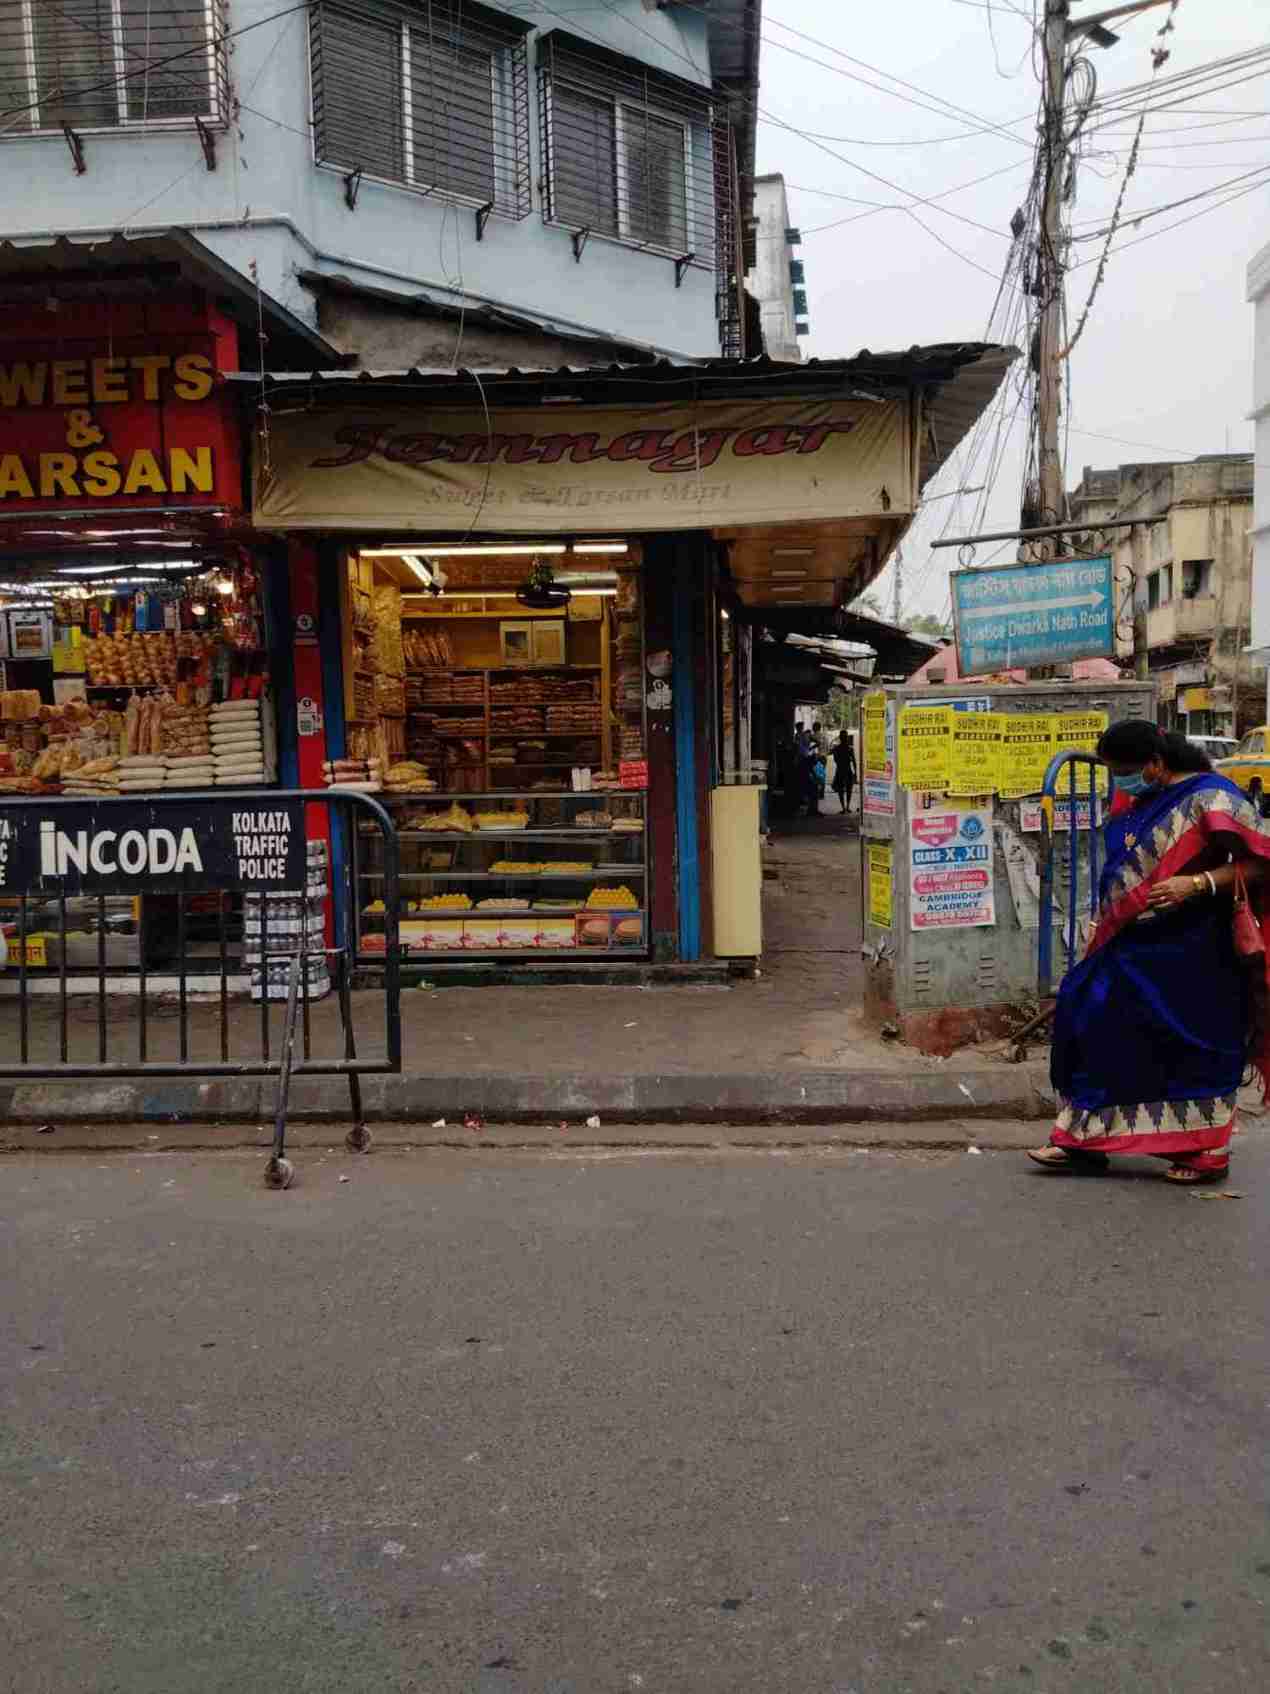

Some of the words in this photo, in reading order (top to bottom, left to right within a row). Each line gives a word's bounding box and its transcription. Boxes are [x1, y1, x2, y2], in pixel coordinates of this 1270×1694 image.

[64, 409, 104, 448] &
[309, 420, 853, 472] Jamnagar
[1080, 608, 1108, 625] Road
[232, 811, 291, 834] KOLKATA
[234, 835, 289, 857] TRAFFIC
[239, 858, 286, 881] POLICE
